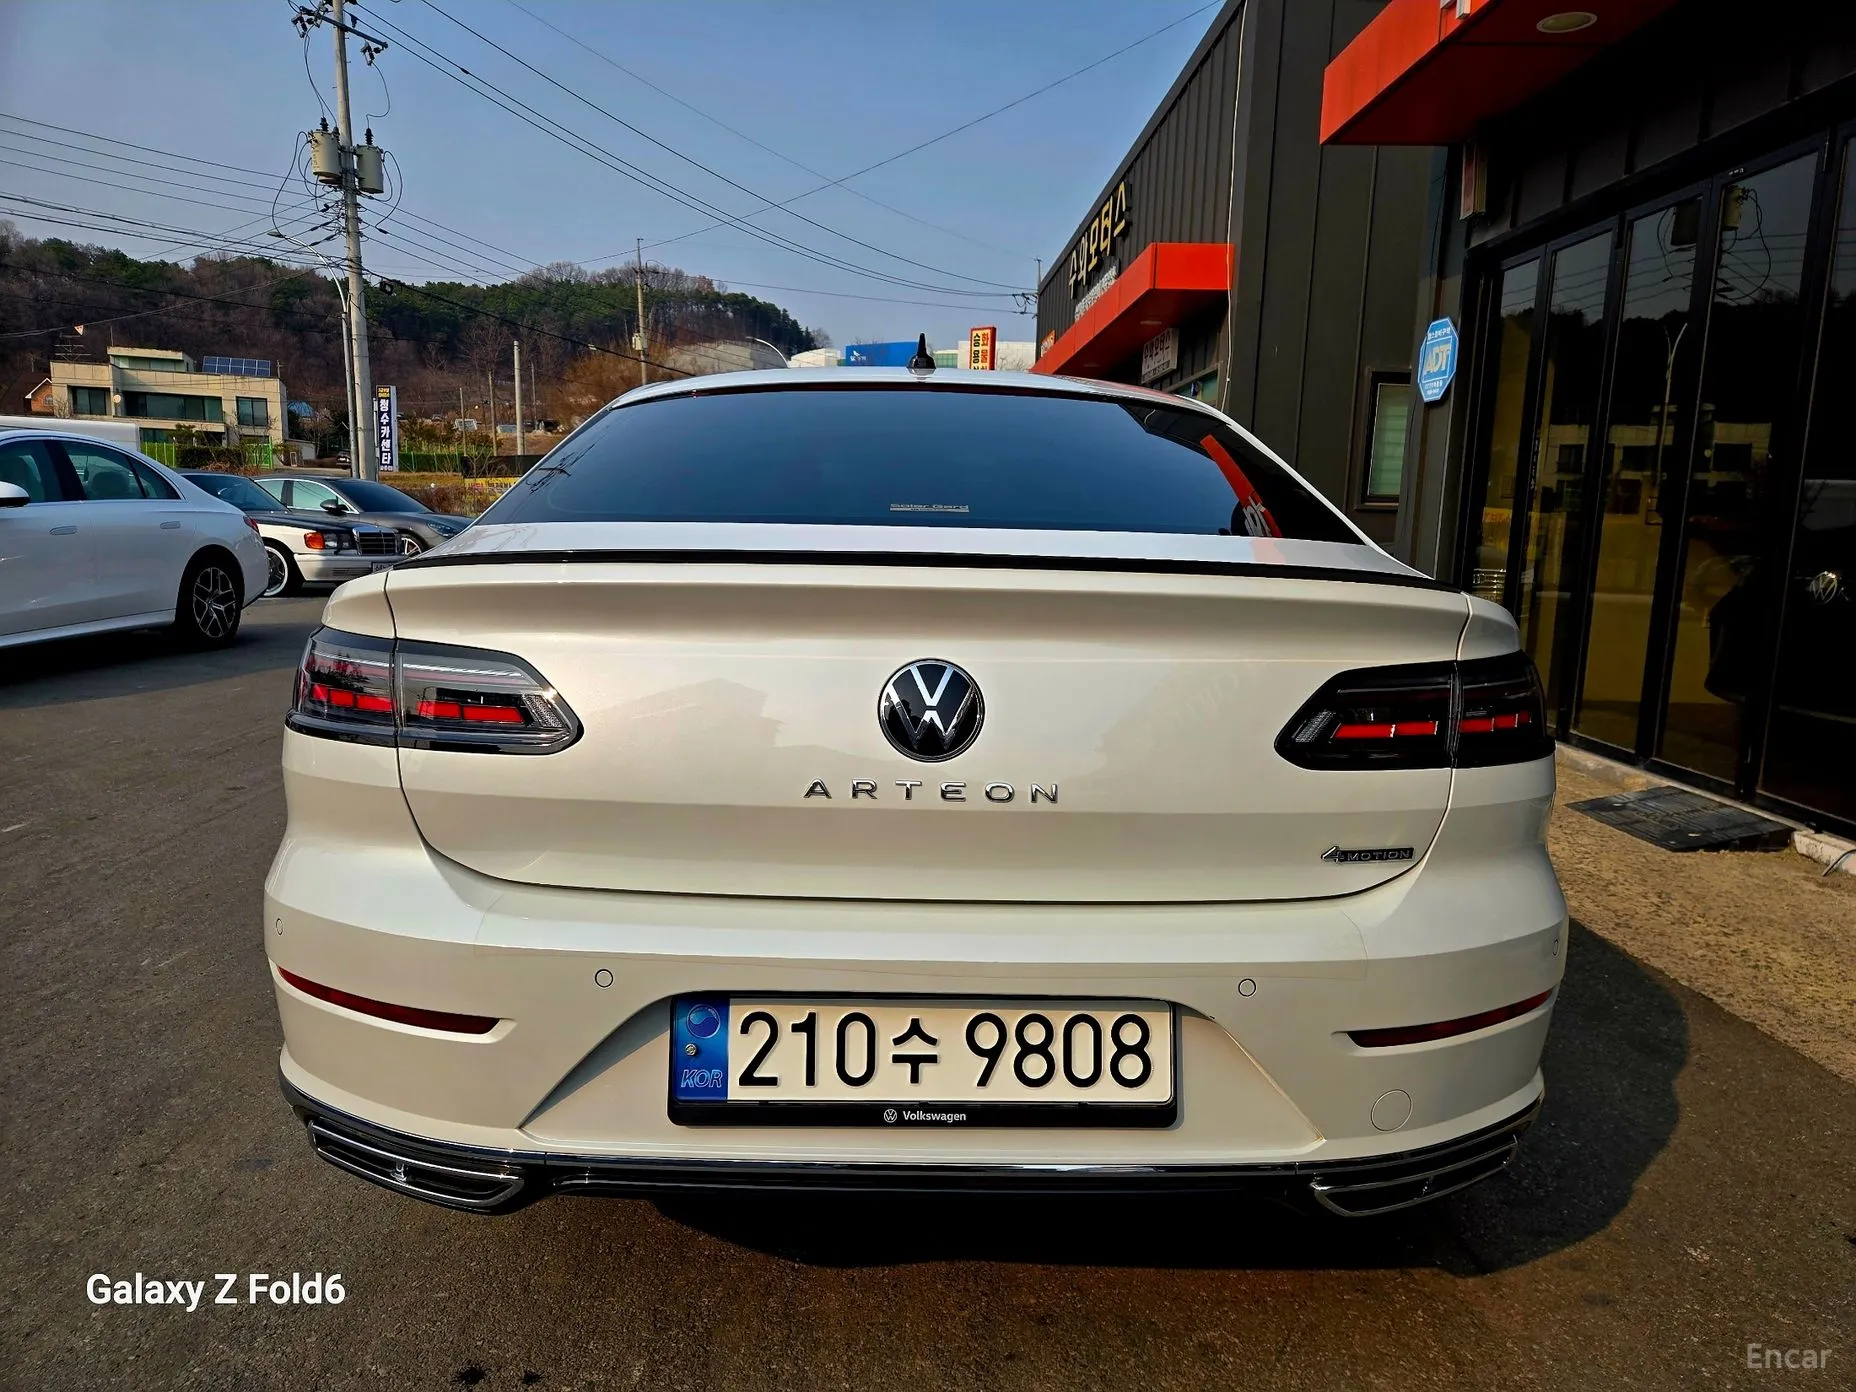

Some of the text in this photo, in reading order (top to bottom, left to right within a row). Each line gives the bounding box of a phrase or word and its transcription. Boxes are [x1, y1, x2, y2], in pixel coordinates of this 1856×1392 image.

[973, 333, 981, 370] 승용
[981, 332, 989, 370] 화물
[1424, 344, 1451, 376] ADT
[803, 777, 1059, 804] ARTEON
[737, 1010, 1153, 1088] 210수 9808
[680, 1069, 723, 1089] KOR
[902, 1110, 967, 1123] Volkswagen
